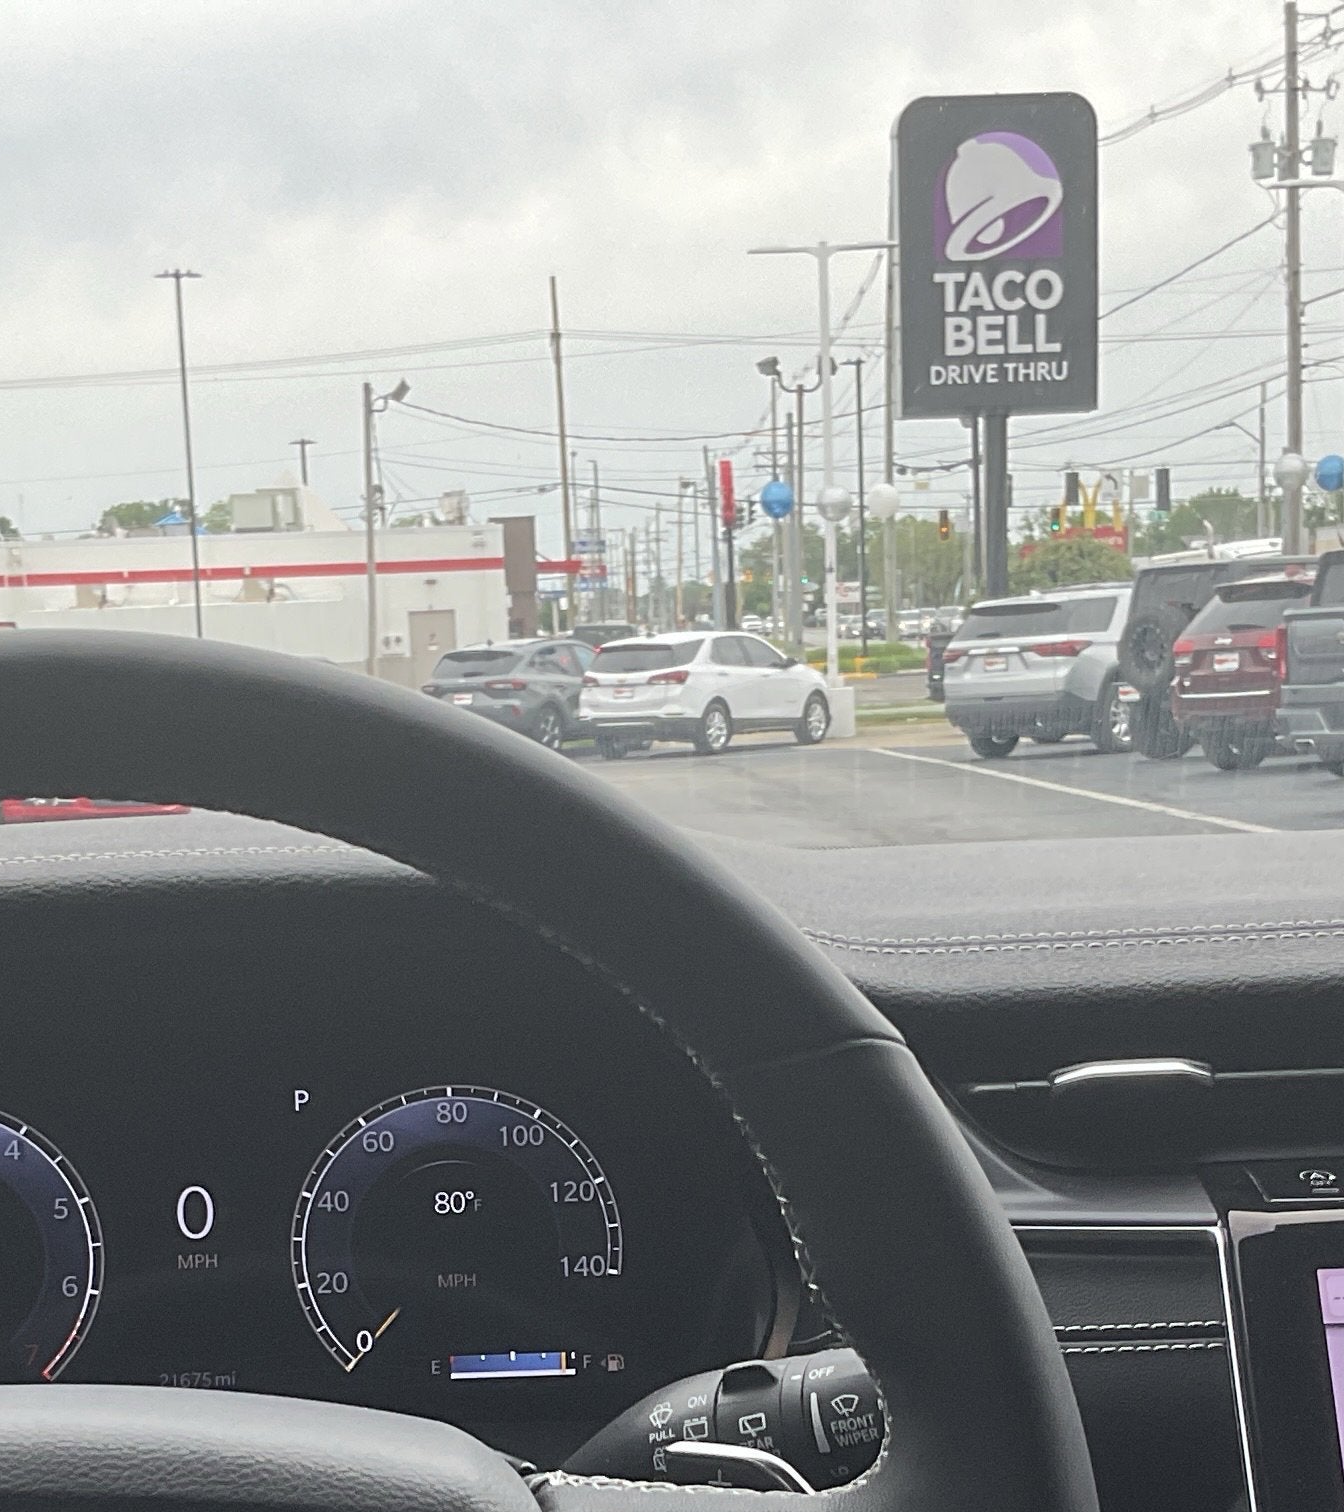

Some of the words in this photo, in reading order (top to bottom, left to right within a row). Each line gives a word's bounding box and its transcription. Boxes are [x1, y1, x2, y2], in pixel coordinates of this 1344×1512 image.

[932, 268, 1064, 313] TACO
[943, 313, 1062, 356] BELL
[929, 363, 999, 386] DRIVE
[1003, 360, 1069, 383] THRU
[293, 1089, 309, 1111] P
[436, 1102, 467, 1123] 80
[362, 1131, 394, 1152] 60
[499, 1125, 544, 1147] 100
[3, 1139, 21, 1160] 4
[317, 1190, 350, 1212] 40
[550, 1180, 595, 1202] 120
[53, 1198, 69, 1219] 5
[175, 1185, 215, 1240] 0
[177, 1254, 218, 1270] MPH
[560, 1255, 606, 1278] 140
[61, 1276, 78, 1298] 6
[317, 1272, 348, 1293] 20
[437, 1274, 477, 1288] MPH
[356, 1330, 374, 1352] 0
[23, 1343, 39, 1366] 7
[583, 1355, 593, 1369] F
[431, 1360, 441, 1375] E
[807, 1365, 835, 1381] OFF
[687, 1394, 708, 1410] ON
[830, 1412, 876, 1435] FRONT
[648, 1428, 676, 1444] PULL
[740, 1435, 774, 1450] EAR
[833, 1427, 881, 1449] WIPER
